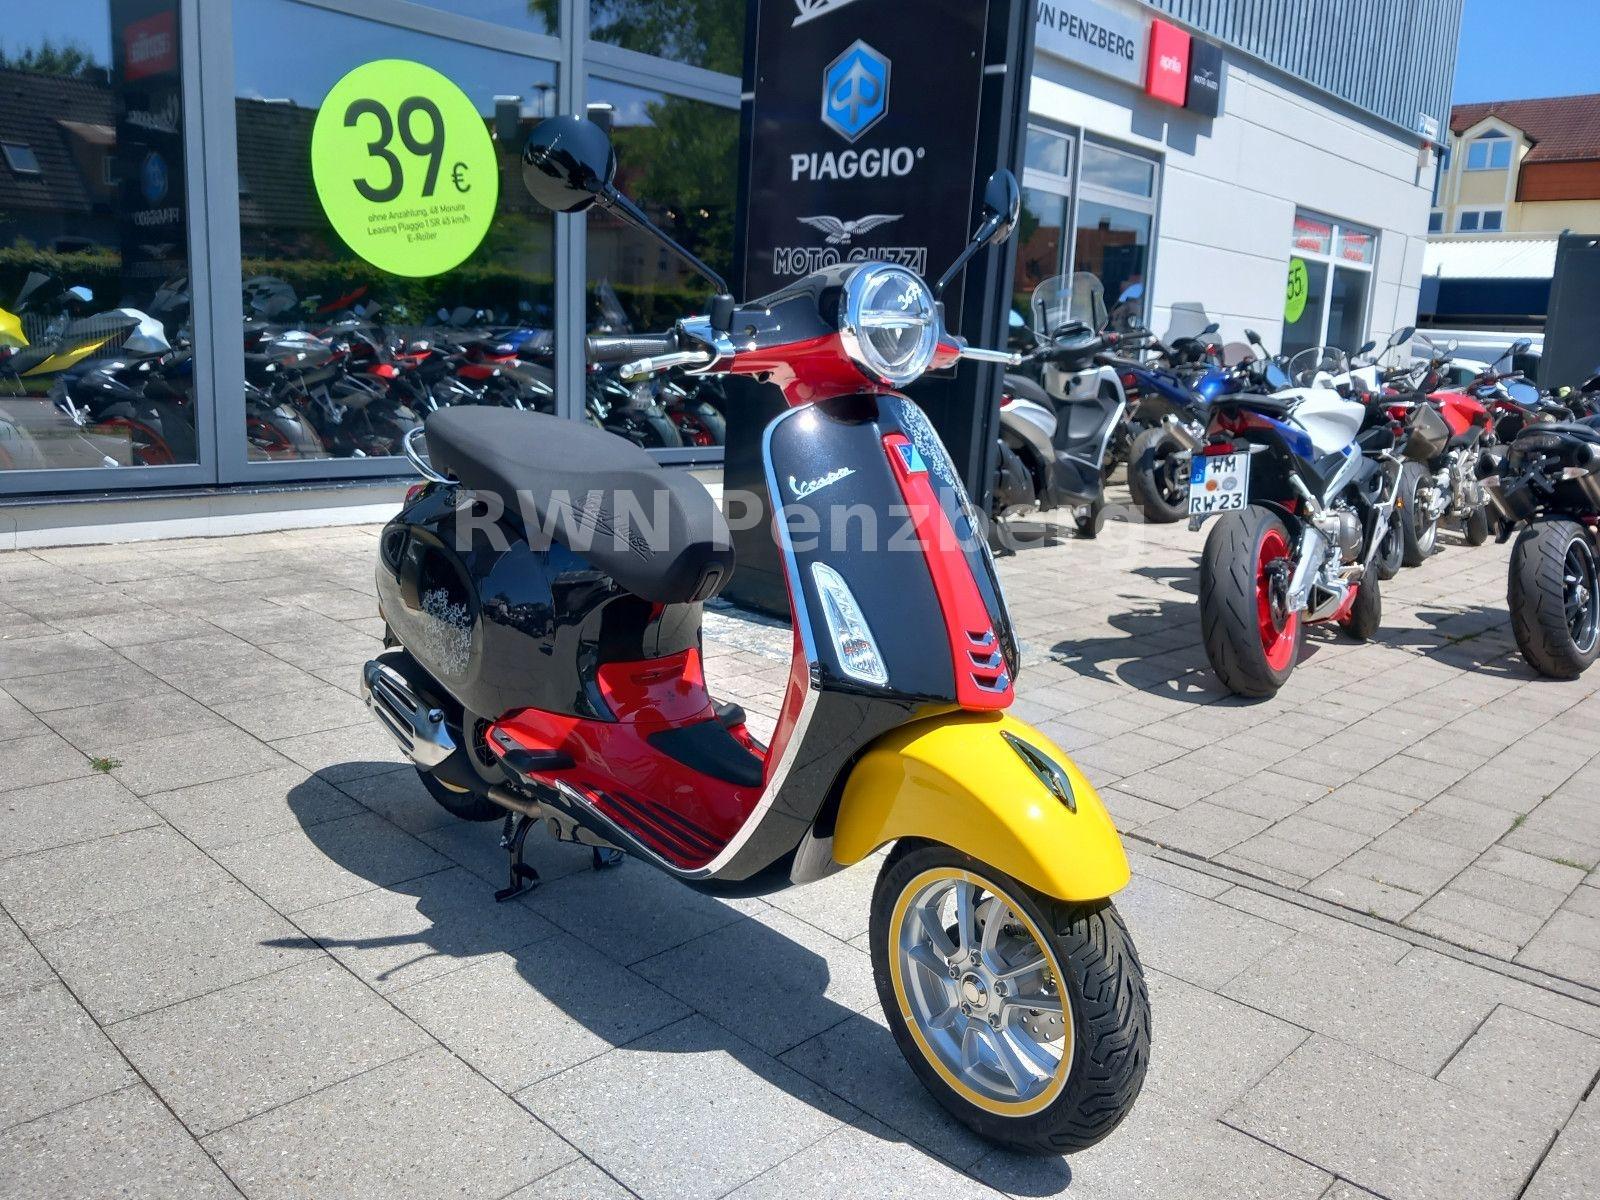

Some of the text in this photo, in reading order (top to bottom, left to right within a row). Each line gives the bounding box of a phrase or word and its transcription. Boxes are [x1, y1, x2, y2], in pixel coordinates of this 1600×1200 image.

[1058, 10, 1135, 61] PENZBERG
[344, 96, 471, 203] 39 €
[791, 147, 914, 181] PIAGGIO
[367, 225, 397, 236] Leasing
[773, 247, 841, 275] MOTO
[1212, 456, 1236, 473] WM
[789, 466, 857, 502] Vespa
